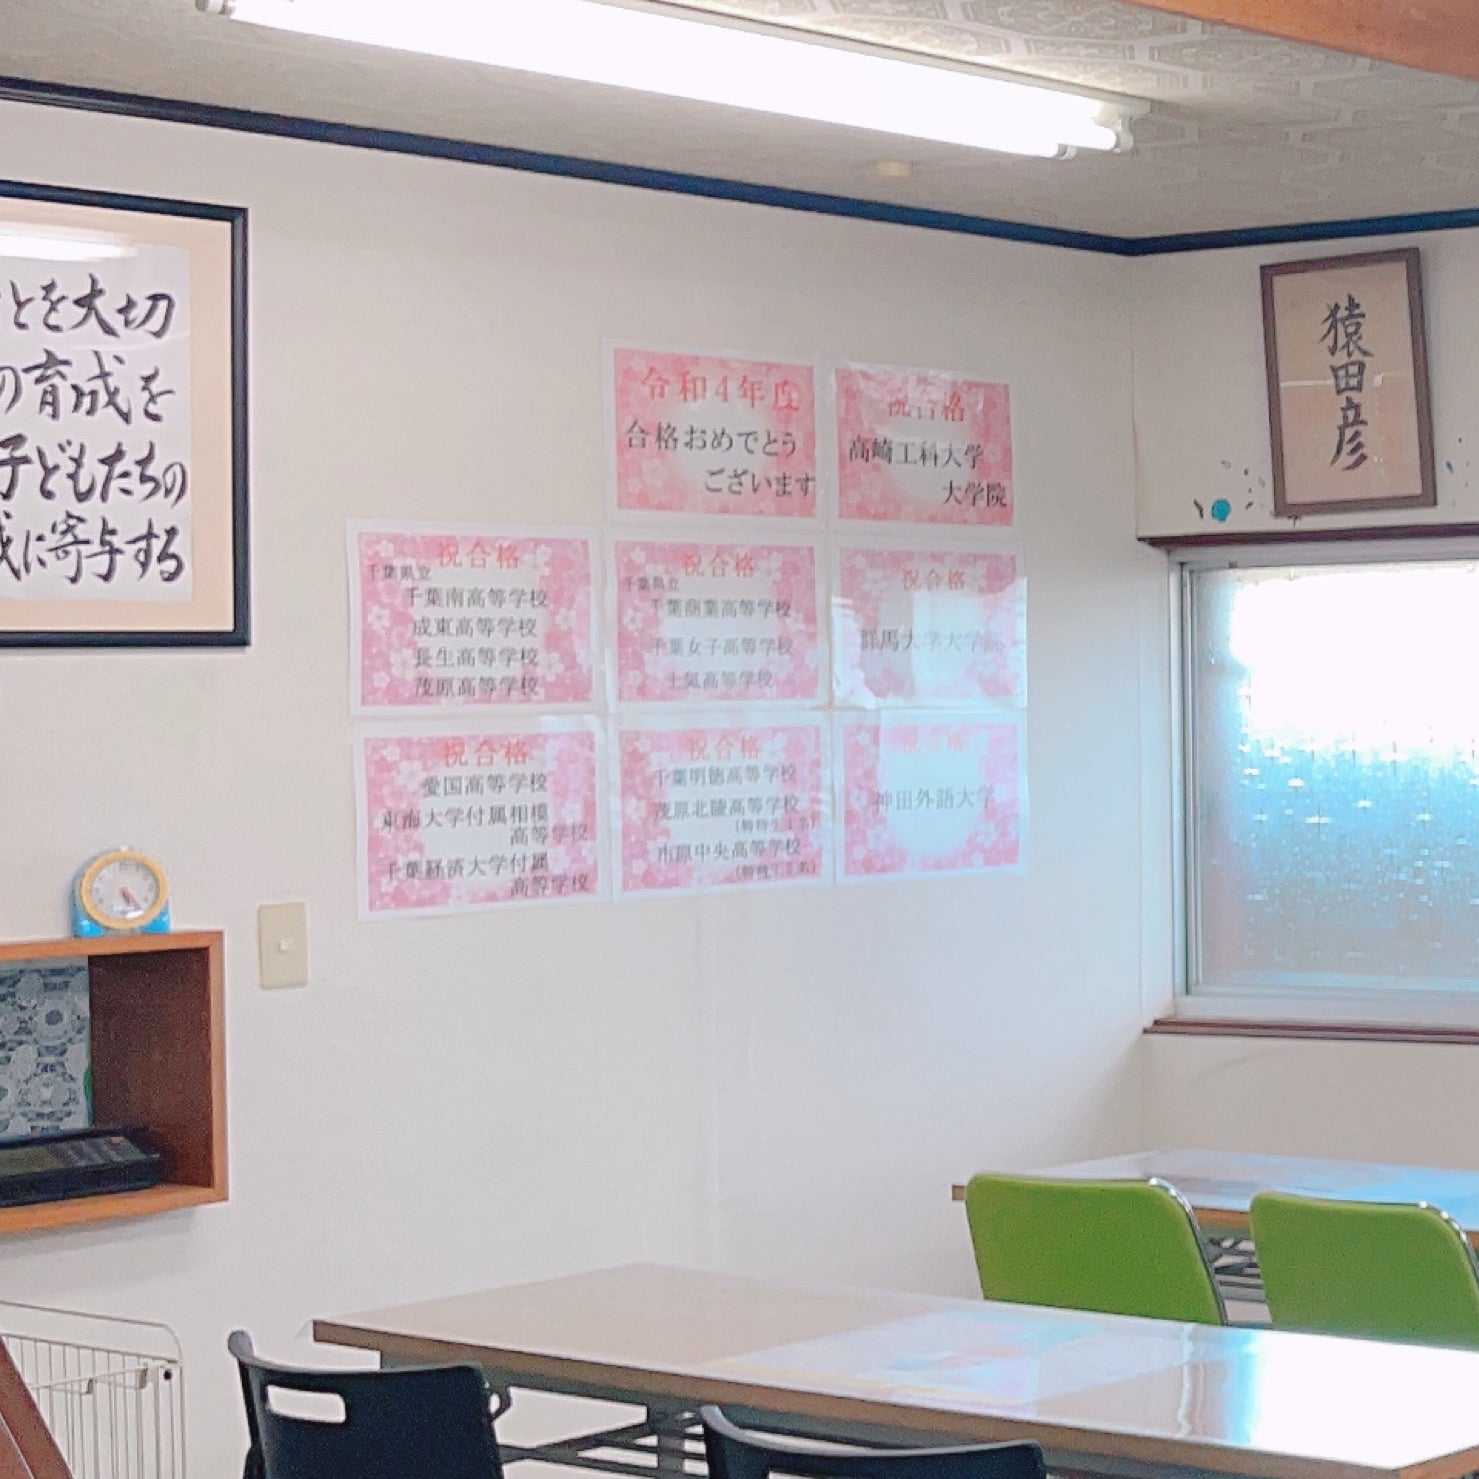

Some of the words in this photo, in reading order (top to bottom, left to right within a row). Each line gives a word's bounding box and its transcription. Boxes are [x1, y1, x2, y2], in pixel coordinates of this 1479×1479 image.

[641, 365, 799, 411] 令和4年度
[1318, 294, 1373, 471] 猿田彦
[625, 419, 796, 458] 合格おめでとう
[704, 467, 815, 498] ございます
[942, 479, 1007, 509] 大学院
[439, 538, 519, 569] 祝合格
[406, 586, 548, 609] 千葉南高等学校
